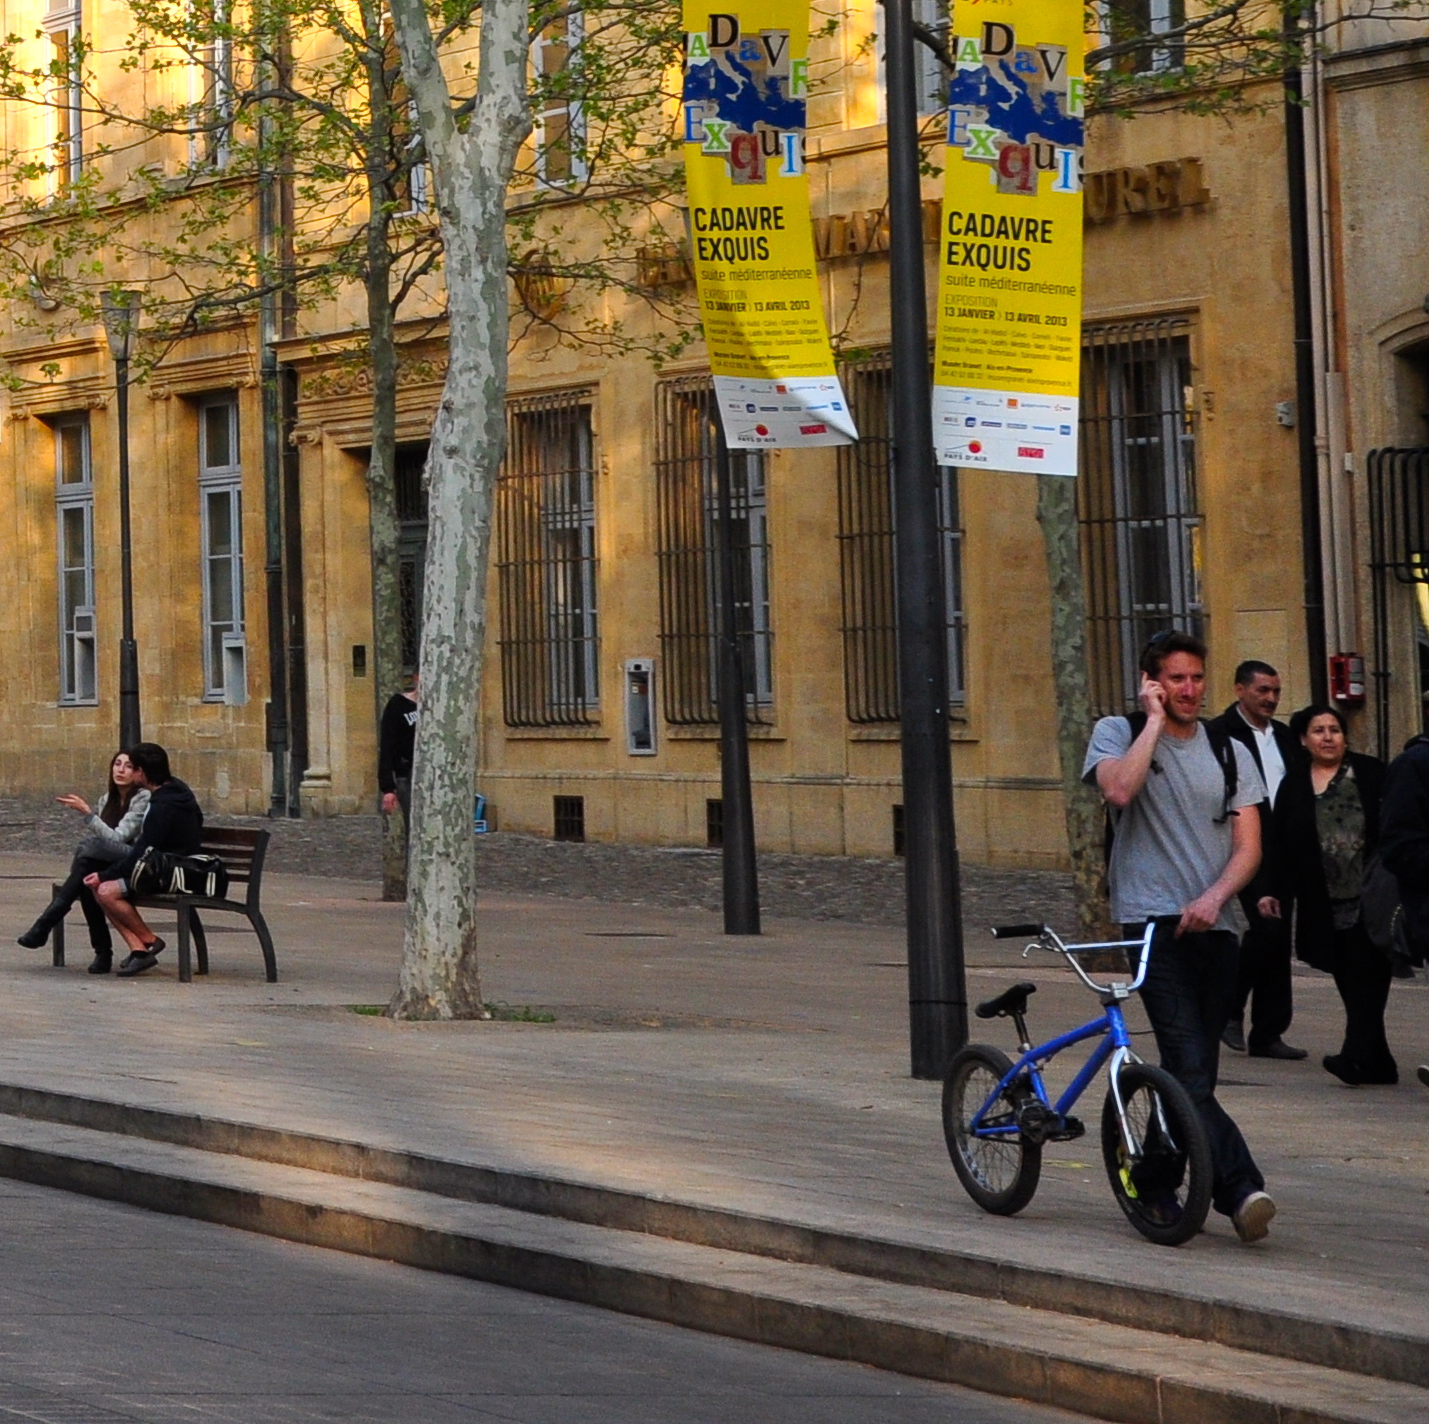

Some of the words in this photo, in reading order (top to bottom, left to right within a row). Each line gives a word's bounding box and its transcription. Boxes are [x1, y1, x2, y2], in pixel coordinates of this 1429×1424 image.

[694, 206, 785, 231] CADAVRE
[948, 211, 1053, 243] CADAVRE
[697, 236, 769, 264] EXQUIS
[947, 241, 1031, 271] EXQUIS
[701, 269, 726, 281] suite
[729, 267, 812, 281] méditerranéenne
[946, 274, 976, 287] suite
[979, 276, 1076, 296] méditerranéenne
[705, 300, 715, 310] 13
[716, 302, 747, 312] JANVIER
[754, 302, 763, 311] 13
[765, 301, 788, 311] AVRIL
[789, 300, 810, 310] 2013
[945, 294, 998, 307] EXPOSITION
[944, 307, 955, 317] 13
[957, 308, 995, 320] JANVIER
[1005, 312, 1014, 321] 13
[1017, 313, 1042, 324] AVRIL
[1045, 315, 1067, 326] 2013
